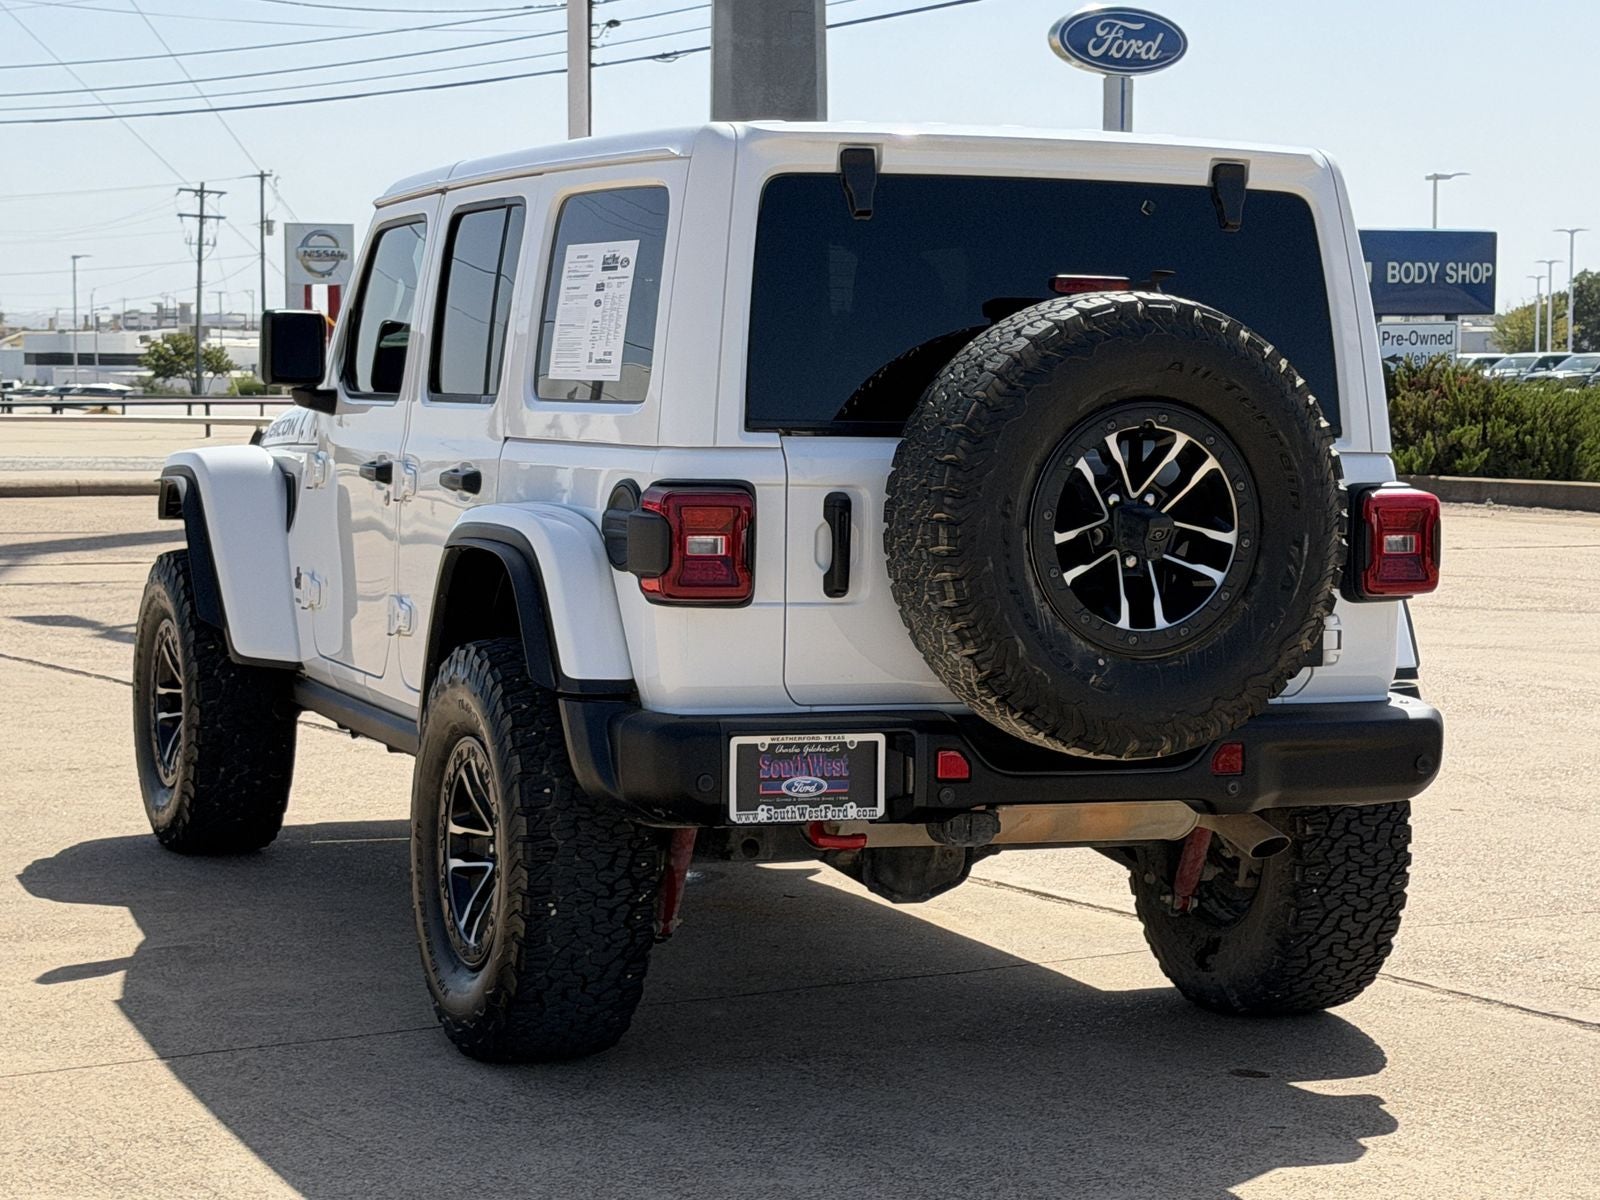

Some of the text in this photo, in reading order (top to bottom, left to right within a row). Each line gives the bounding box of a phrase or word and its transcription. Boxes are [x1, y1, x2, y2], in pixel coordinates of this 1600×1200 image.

[1087, 19, 1164, 60] Ford
[303, 249, 345, 259] NISSAN
[1386, 261, 1440, 284] BODY
[1445, 261, 1493, 284] SHOP
[1381, 330, 1453, 346] Pre-Owned
[1406, 352, 1453, 365] Vehis
[791, 778, 818, 793] Ford
